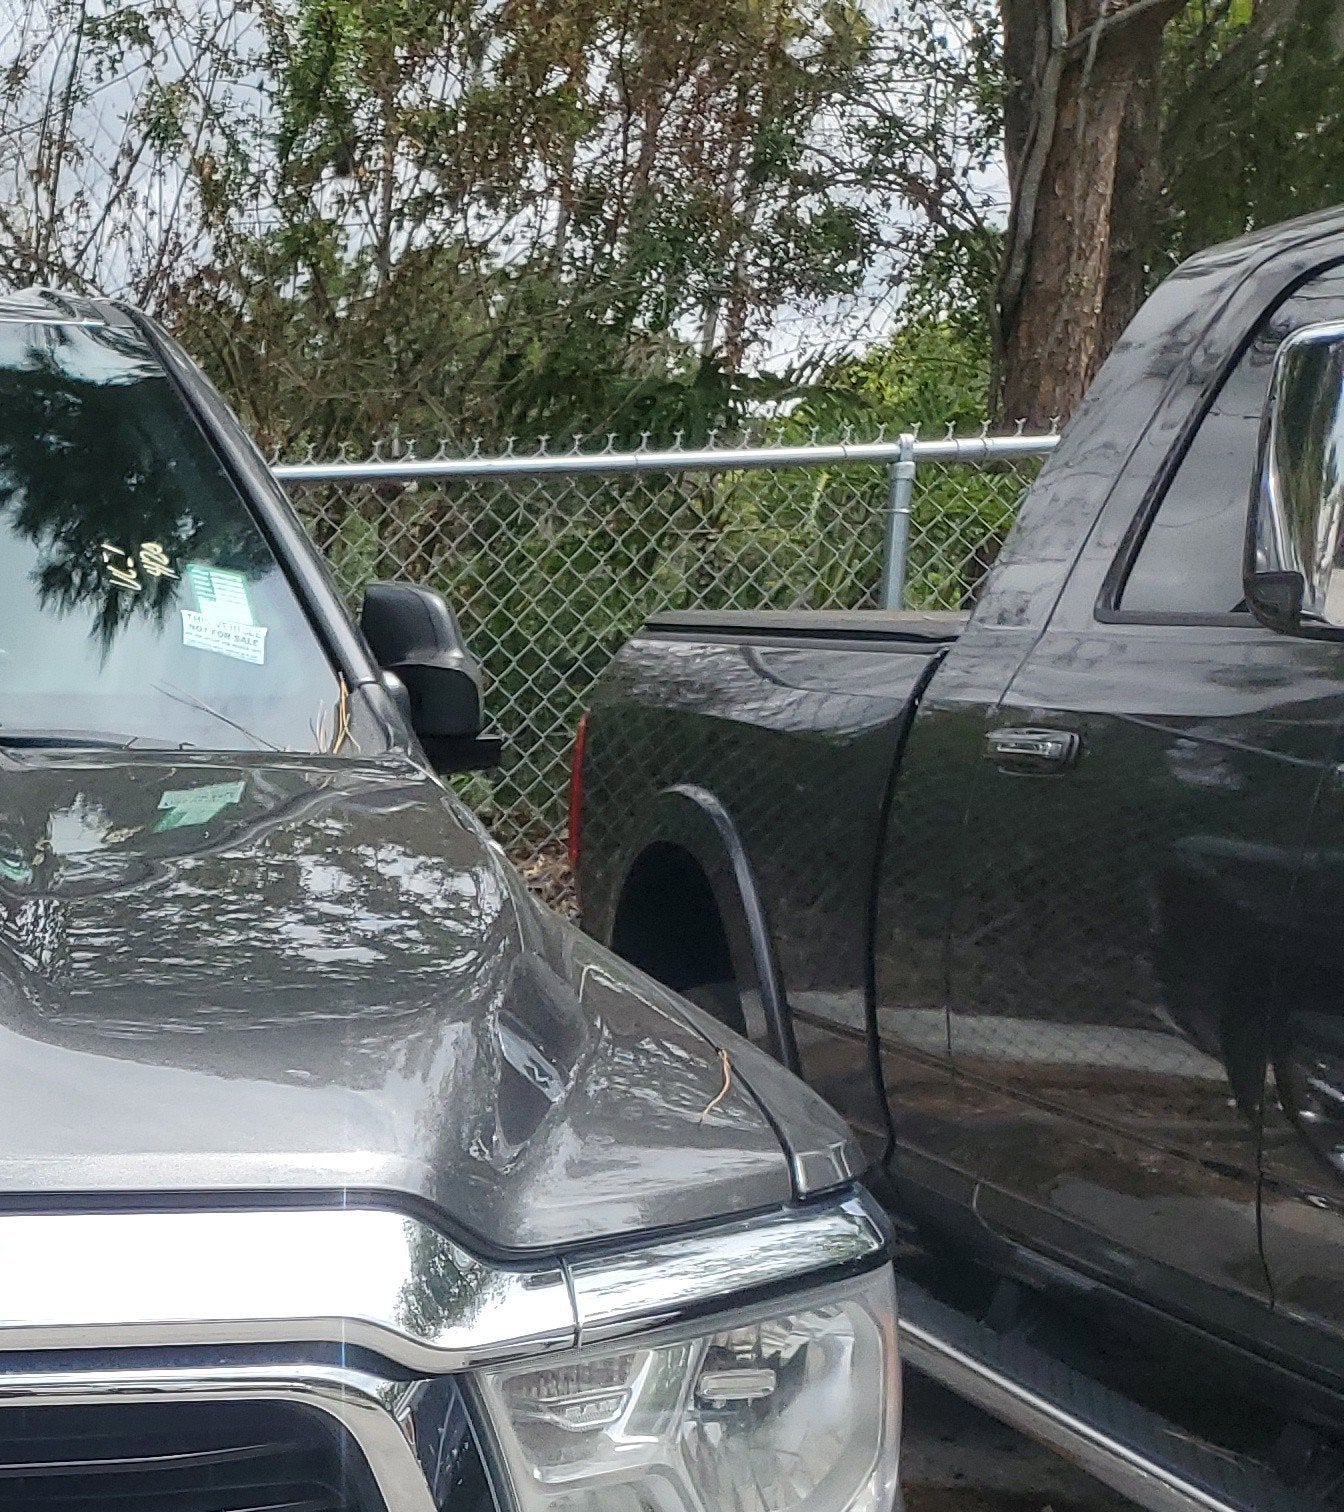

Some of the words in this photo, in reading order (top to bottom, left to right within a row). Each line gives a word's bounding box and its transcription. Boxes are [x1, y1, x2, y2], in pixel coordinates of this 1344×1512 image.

[189, 624, 208, 633] NOT
[211, 629, 231, 640] FOR
[234, 635, 259, 647] SALE
[217, 621, 262, 639] VEHILE
